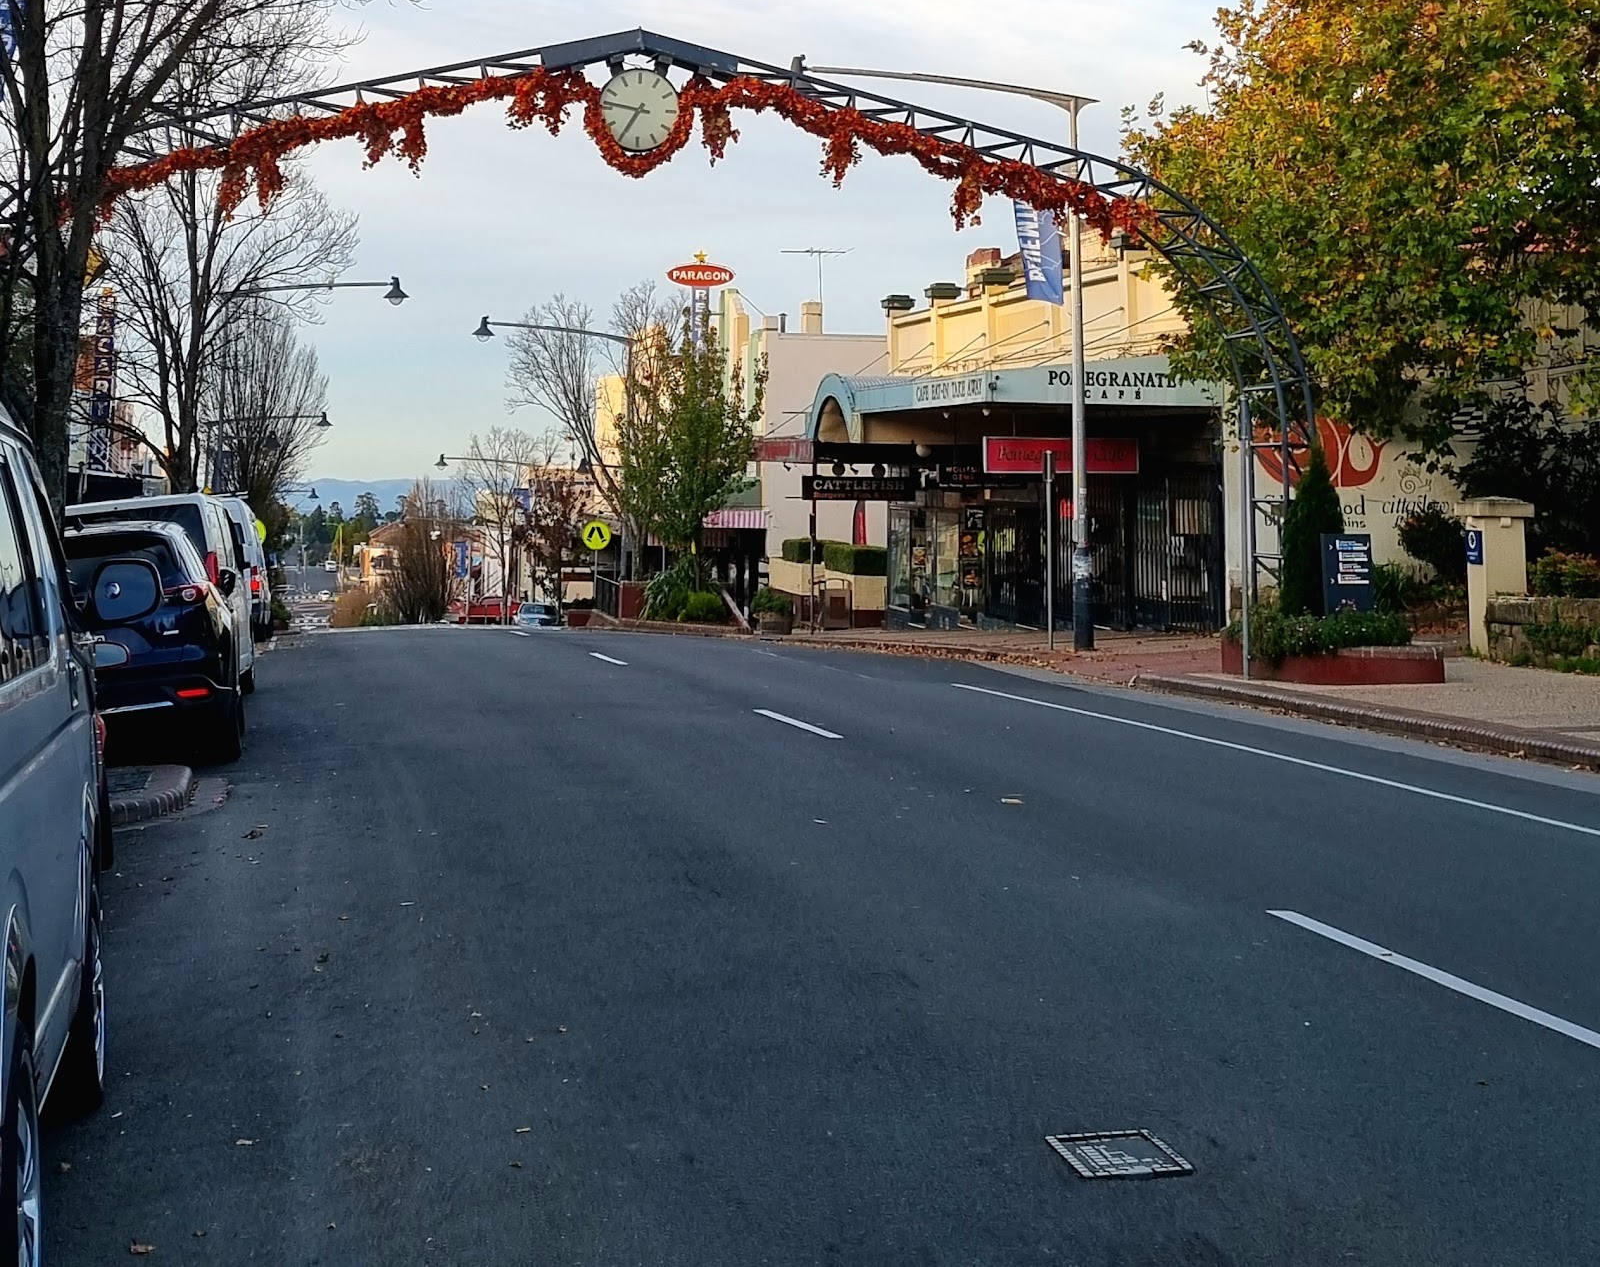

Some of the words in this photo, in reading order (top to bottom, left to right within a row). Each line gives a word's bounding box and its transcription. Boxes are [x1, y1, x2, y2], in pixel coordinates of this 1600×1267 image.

[672, 270, 730, 281] PARAGON
[1048, 370, 1177, 388] POEGRANATE
[916, 384, 929, 402] CAFE
[951, 380, 966, 398] TAKE
[967, 378, 983, 396] AWAY
[1084, 387, 1142, 400] CAFÉ
[813, 479, 905, 490] CATTLEFISH
